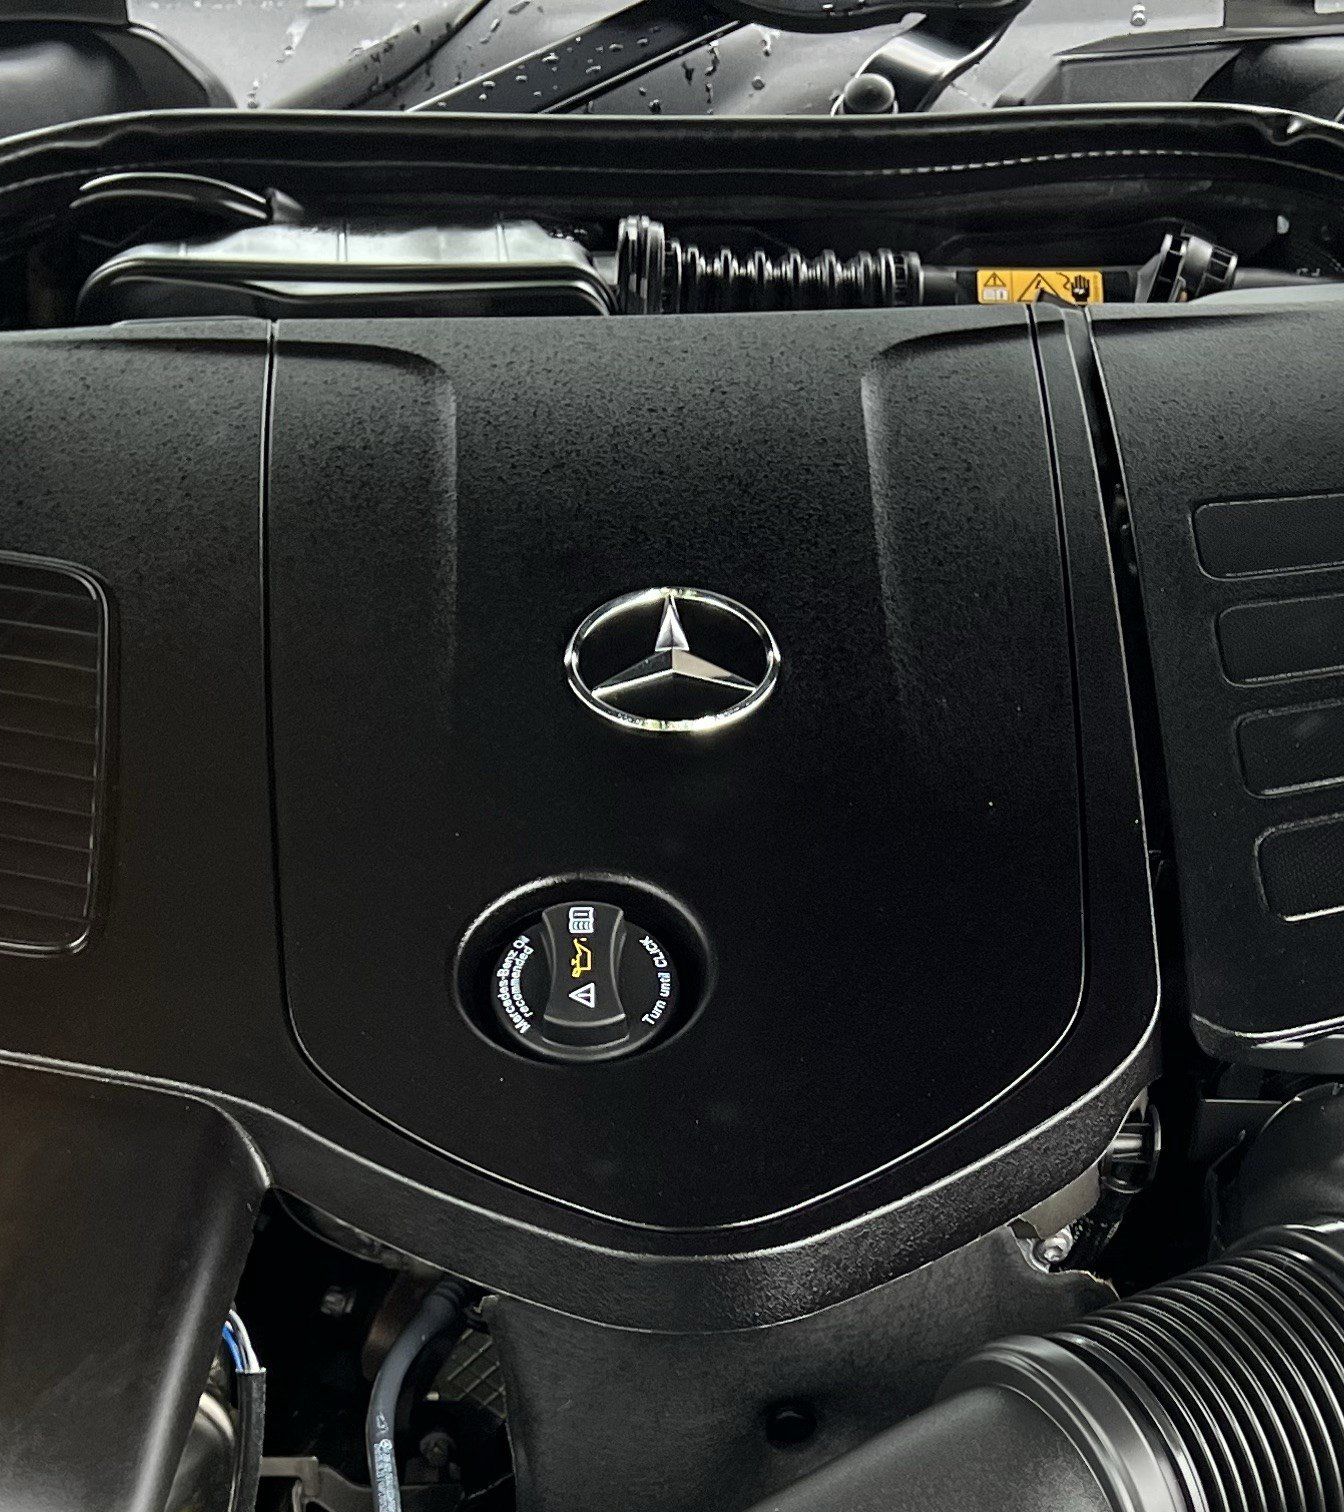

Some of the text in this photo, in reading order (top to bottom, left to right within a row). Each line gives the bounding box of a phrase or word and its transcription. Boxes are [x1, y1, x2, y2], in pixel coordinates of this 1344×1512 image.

[497, 935, 531, 1034] Mercedes-Benz Oil
[510, 945, 534, 1018] recommended
[639, 936, 671, 1025] Turn until CLICK
